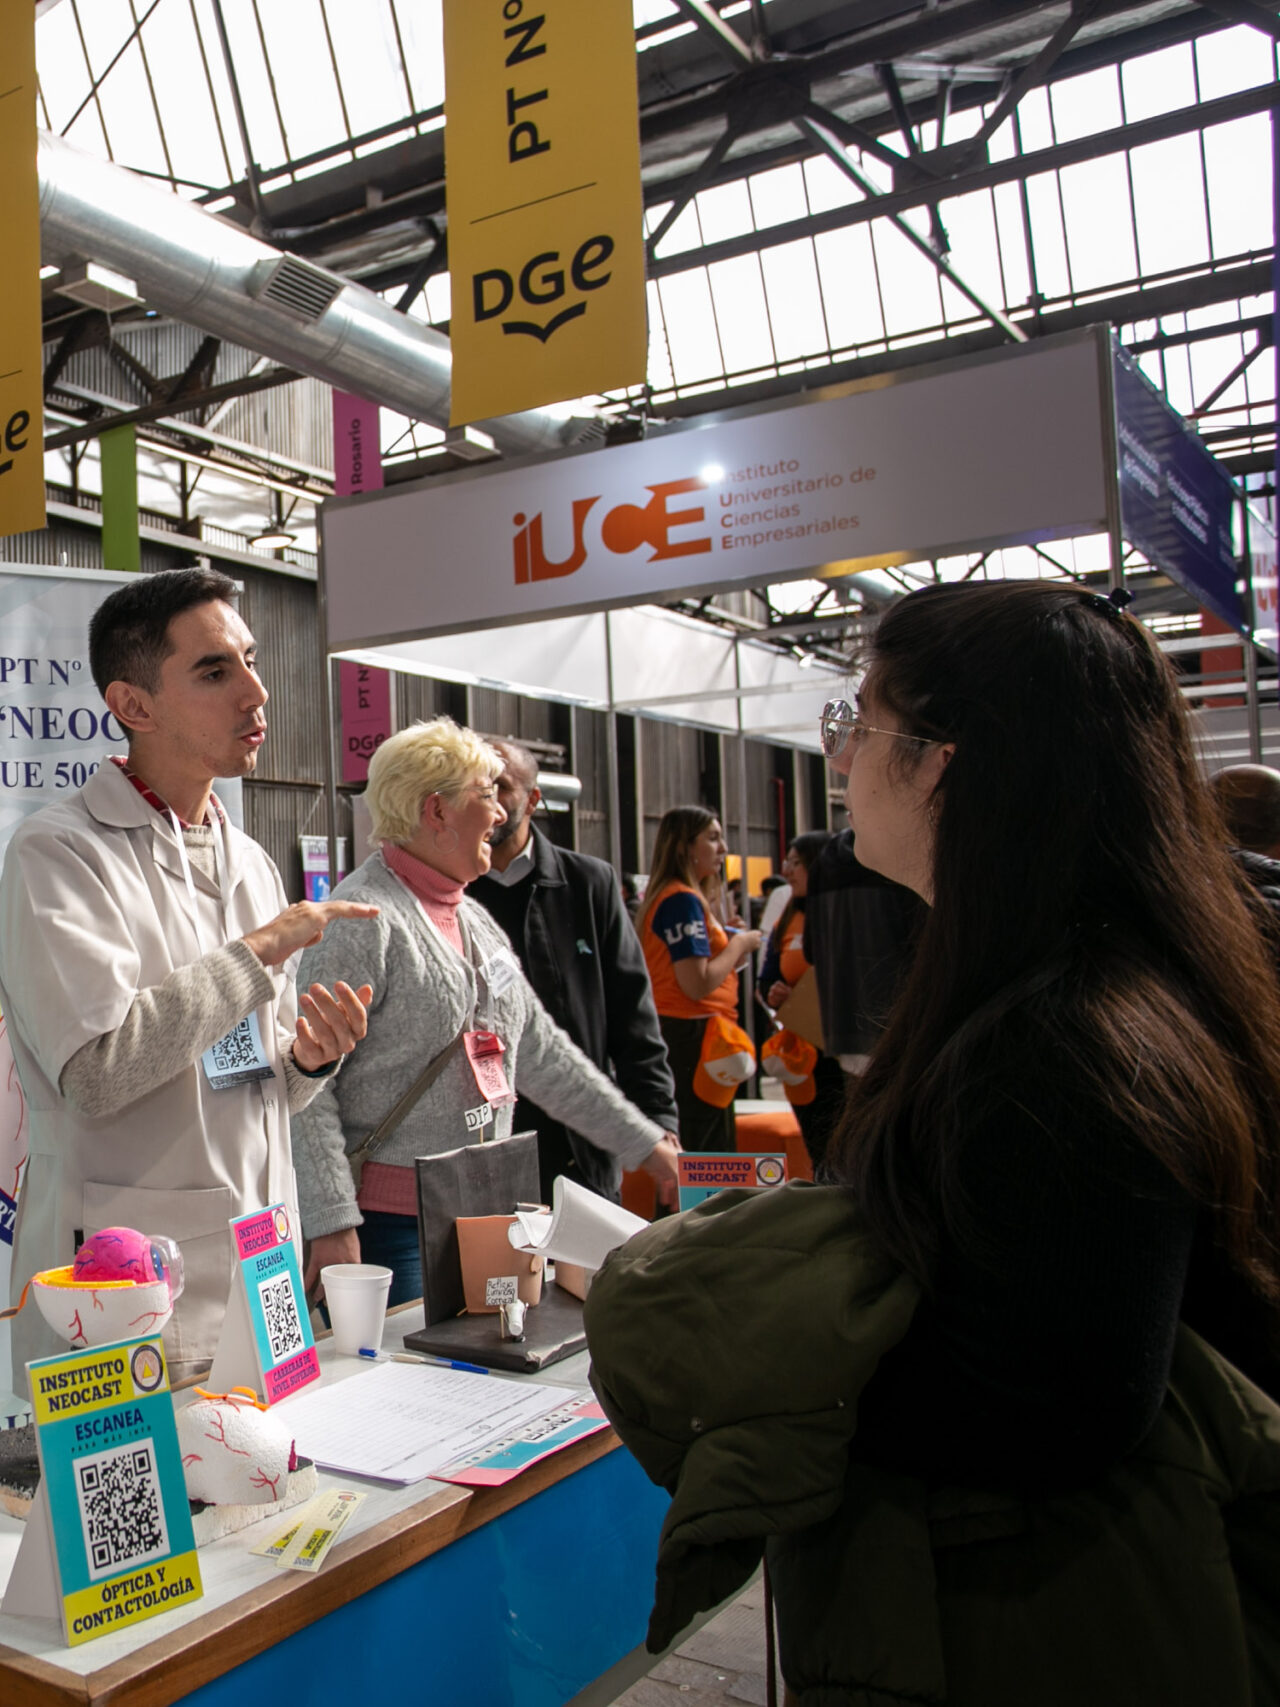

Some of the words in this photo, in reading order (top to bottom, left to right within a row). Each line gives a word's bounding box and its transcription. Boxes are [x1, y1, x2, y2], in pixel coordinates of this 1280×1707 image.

[506, 87, 551, 164] PT
[349, 418, 363, 484] Rosario
[720, 473, 843, 508] Universitario
[849, 466, 877, 484] de
[725, 459, 800, 483] nstituto
[721, 503, 800, 528] Ciencias
[722, 515, 860, 549] Empresariales
[358, 687, 370, 709] PT
[683, 1161, 751, 1171] INSTITUTO
[688, 1173, 748, 1183] NEOCAST
[238, 1217, 273, 1240] INSTITUTO
[243, 1232, 273, 1253] NEOCAST
[256, 1250, 285, 1272] ESCANEA
[39, 1358, 124, 1394] INSTITUTO
[273, 1380, 290, 1397] NIVEL
[290, 1364, 317, 1386] SUPERIOR
[274, 1358, 303, 1382] CARRERAS
[304, 1353, 312, 1365] DE
[47, 1380, 122, 1413] NEOCAST
[74, 1408, 144, 1441] ESCANEA
[101, 1572, 153, 1603] ÓPTICA
[156, 1567, 166, 1582] Y
[73, 1575, 195, 1634] CONTACTOLOGÍA
